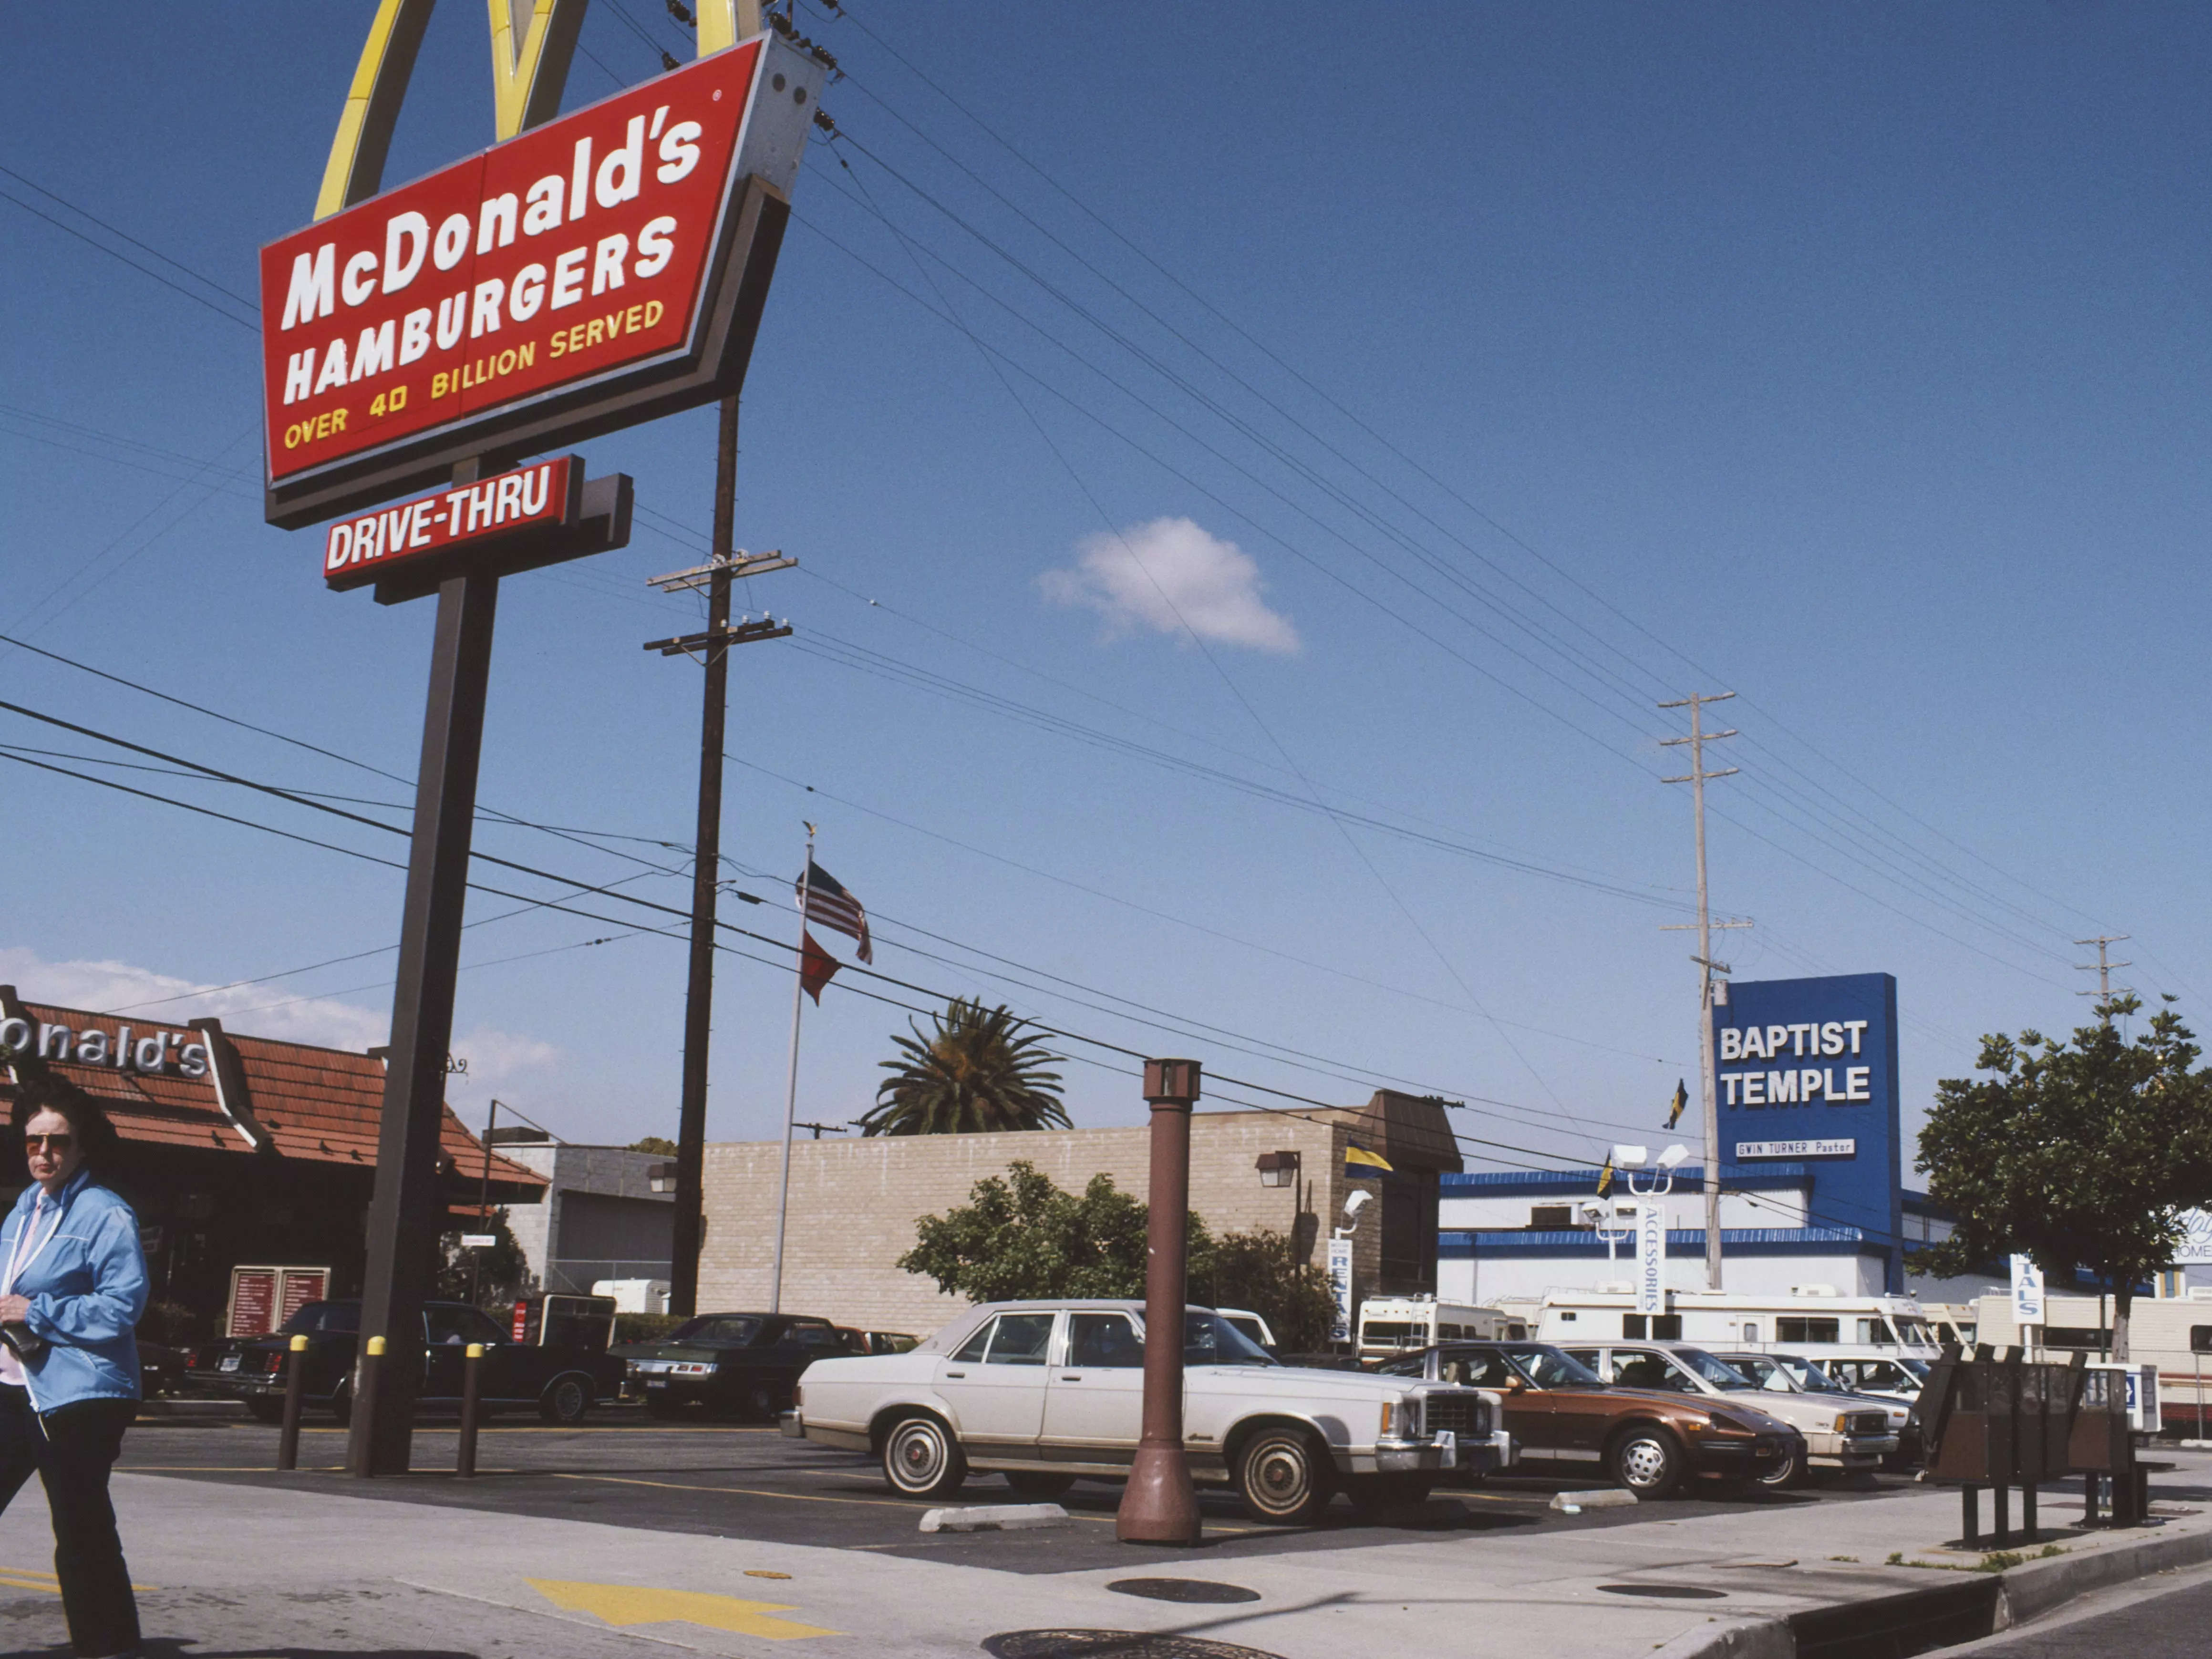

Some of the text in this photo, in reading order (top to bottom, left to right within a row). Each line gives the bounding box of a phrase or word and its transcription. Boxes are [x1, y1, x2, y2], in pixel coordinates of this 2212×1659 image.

[281, 106, 703, 330] McDonald's
[283, 216, 677, 404] HAMBURGERS
[284, 300, 664, 449] OVER 40 BILLION SERVED
[327, 465, 550, 569] DRIVE-THRU
[0, 1018, 208, 1079] onald's
[1720, 1020, 1868, 1061] BAPTIST
[1720, 1066, 1871, 1105] TEMPLE
[1739, 1142, 1850, 1154] GWIN TURNER Pastor
[1644, 1207, 1658, 1312] ACCESSORIES
